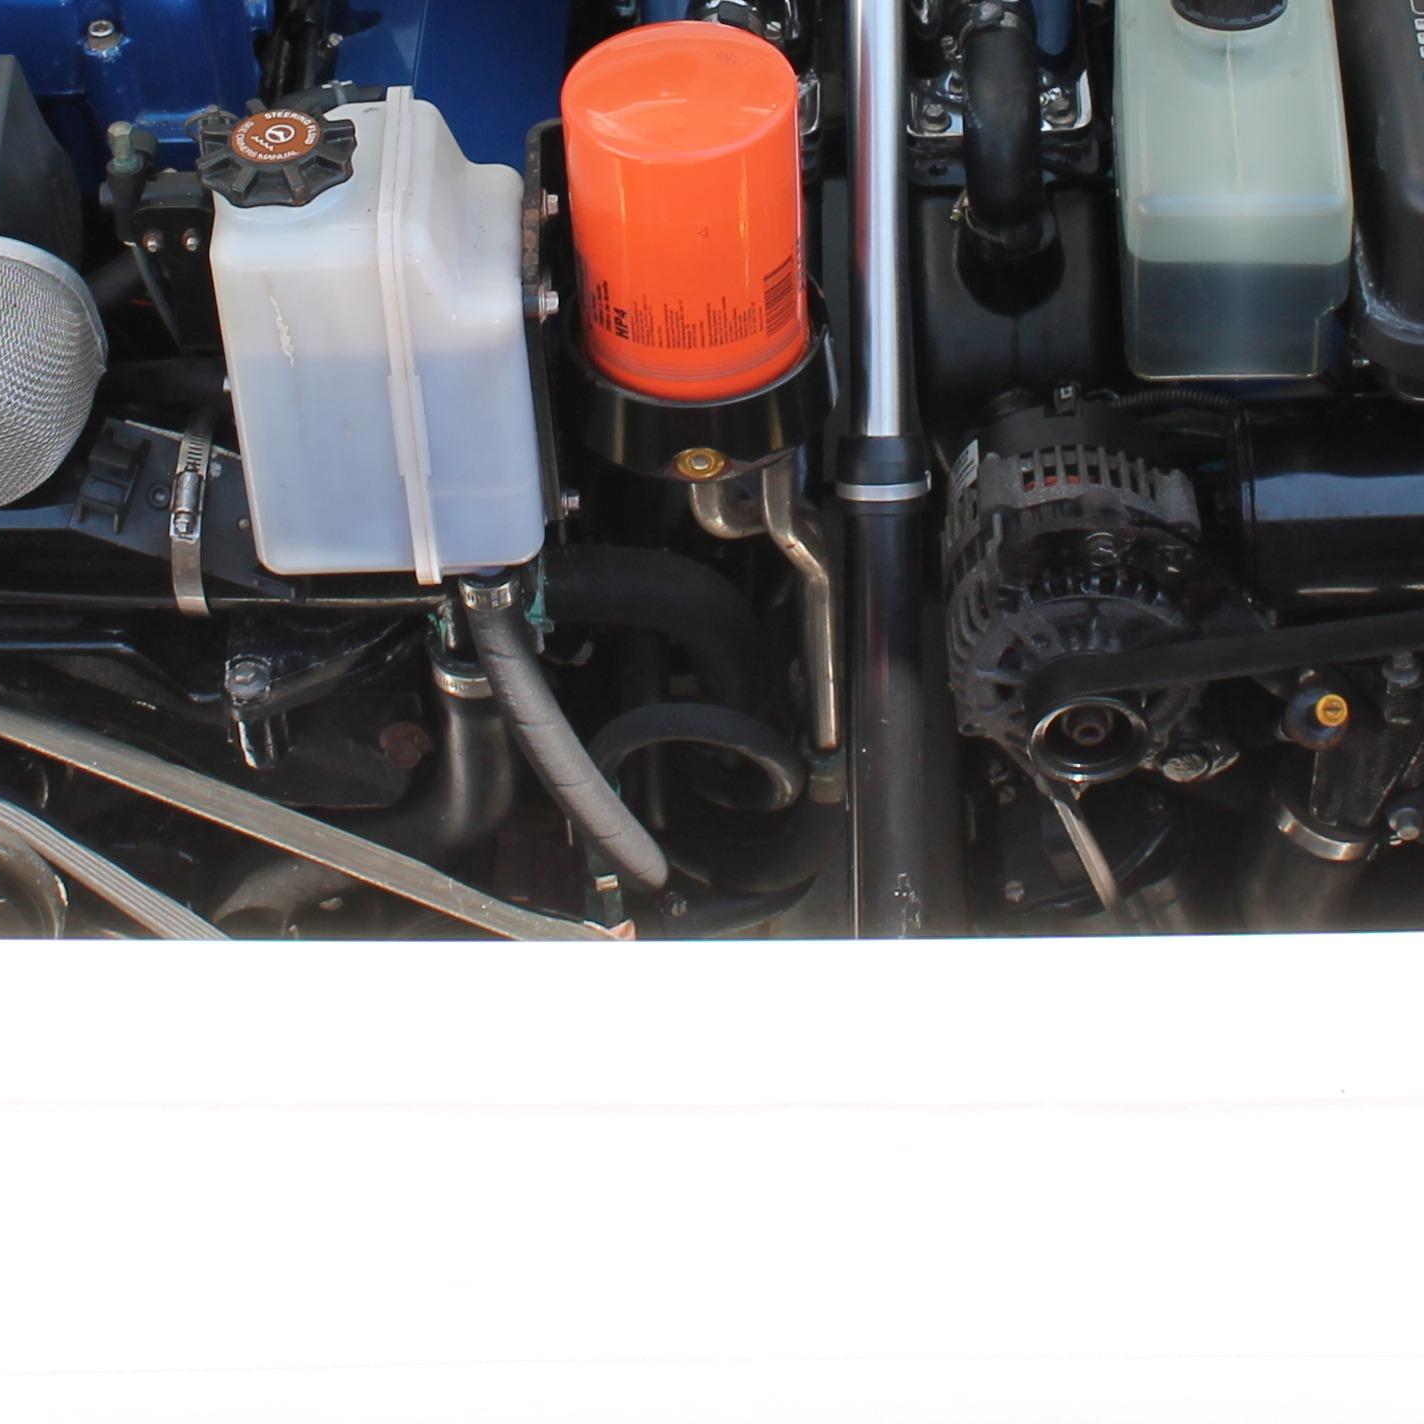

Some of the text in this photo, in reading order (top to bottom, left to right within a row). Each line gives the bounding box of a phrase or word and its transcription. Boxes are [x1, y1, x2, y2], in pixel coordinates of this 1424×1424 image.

[264, 111, 317, 145] STEERING FLUID
[613, 306, 630, 340] HP4
